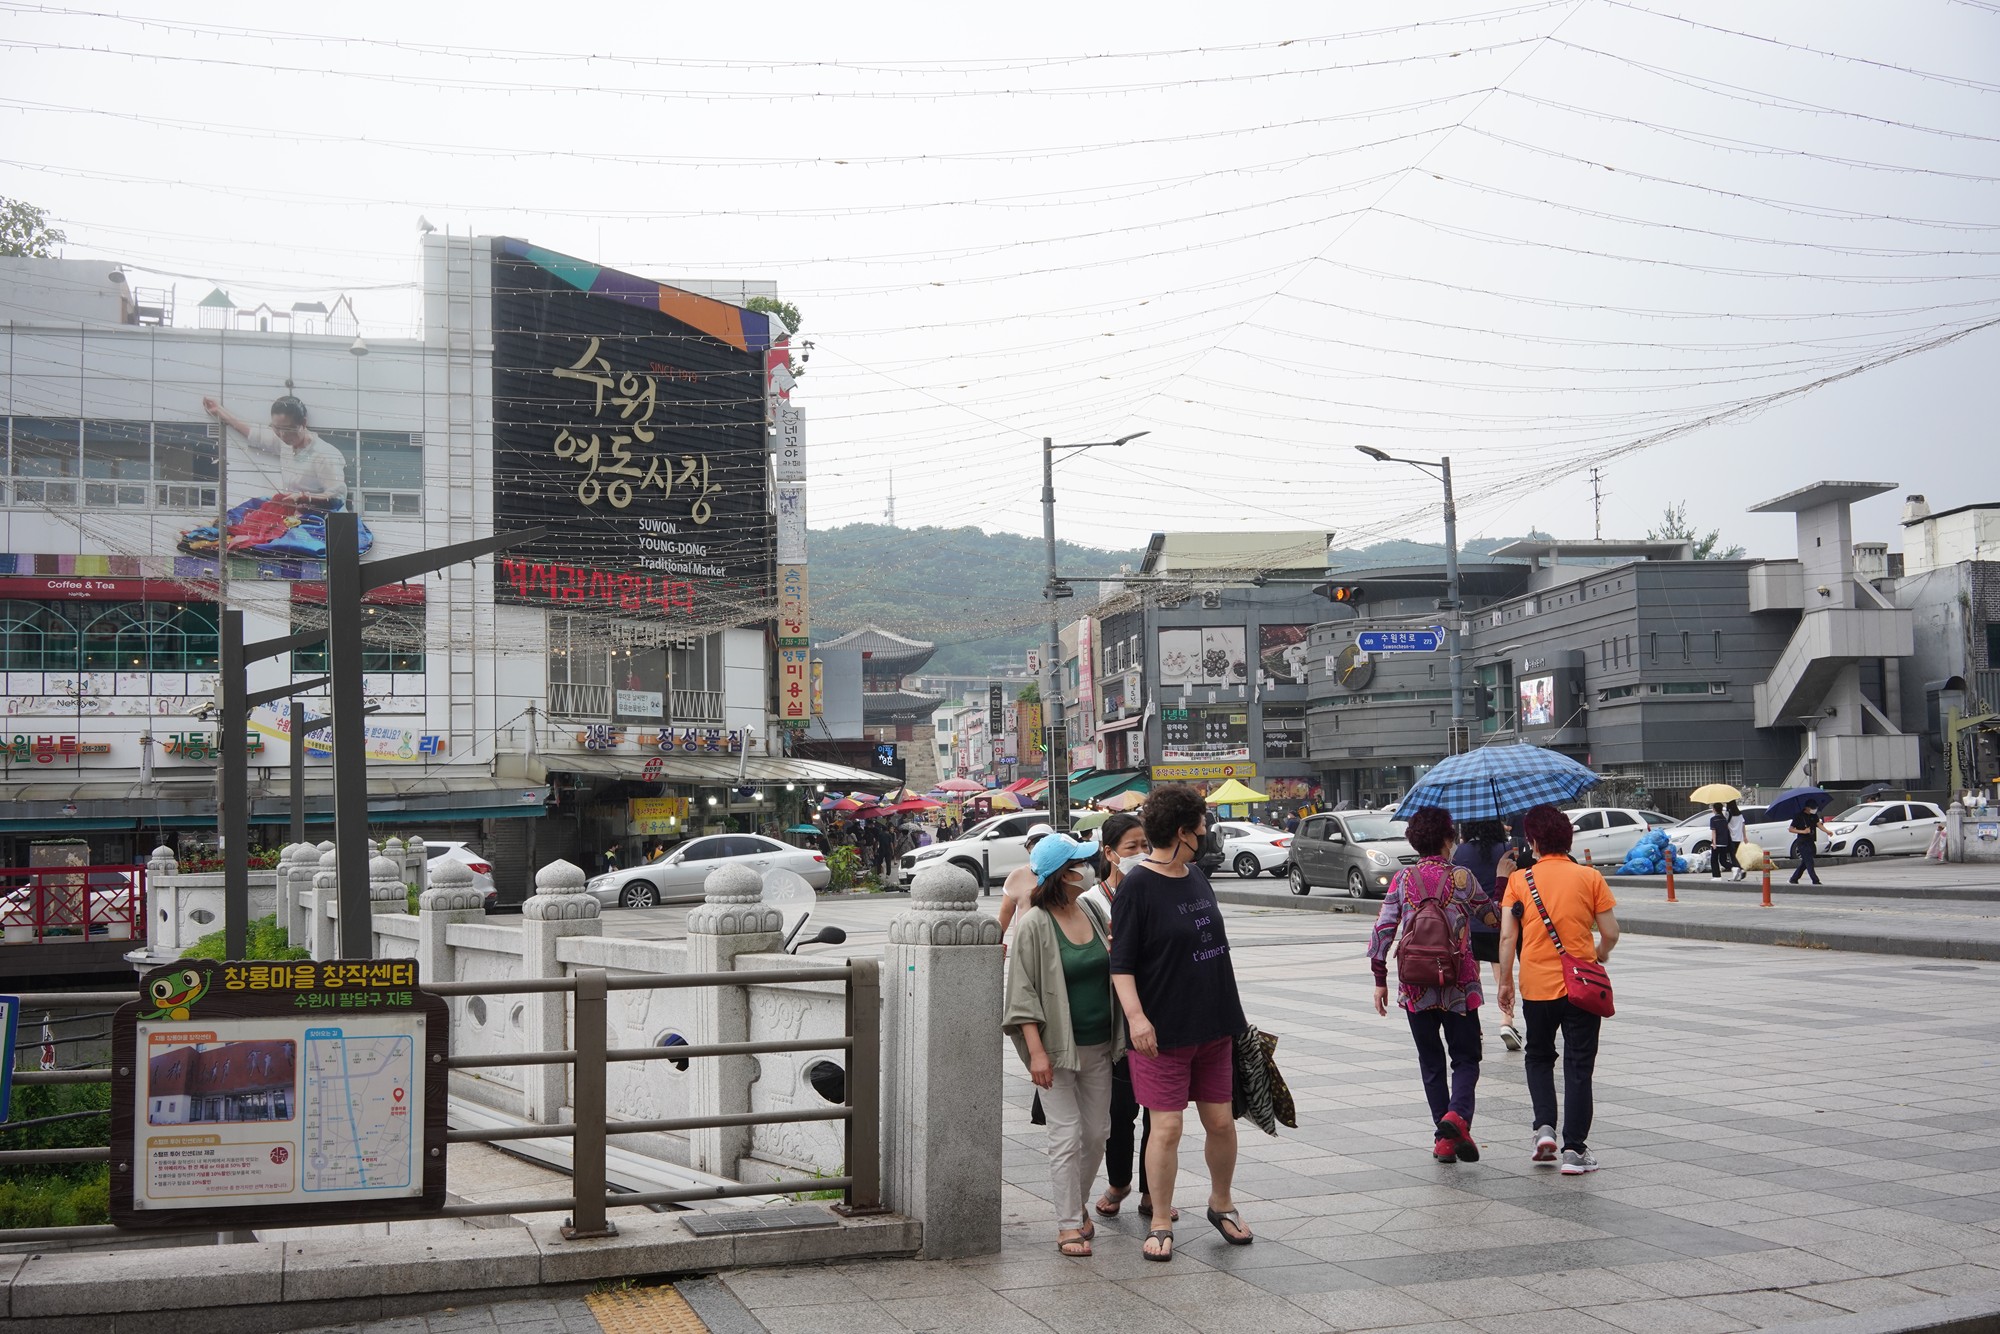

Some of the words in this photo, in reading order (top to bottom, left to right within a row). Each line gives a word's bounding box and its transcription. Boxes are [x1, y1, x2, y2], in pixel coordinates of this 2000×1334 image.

[650, 362, 674, 379] SINCE
[552, 337, 656, 442] 수원
[554, 428, 722, 525] 영동시장
[639, 519, 676, 534] SUWON
[639, 537, 707, 557] YOUNG-DONG
[639, 556, 692, 573] Traditional
[693, 565, 726, 577] Market
[47, 580, 82, 589] Coffee
[85, 581, 92, 589] &
[95, 581, 115, 589] Tea
[1381, 634, 1416, 643] 수원천로
[787, 665, 802, 716] 미용실
[585, 725, 617, 749] 강원도
[657, 727, 743, 752] 정성꽃집
[1195, 915, 1211, 930] pas
[1201, 931, 1212, 943] de
[1192, 945, 1226, 962] t'aimer
[225, 966, 316, 990] 창룡마을
[323, 964, 414, 988] 창작센터
[294, 993, 335, 1008] 수원시
[340, 992, 382, 1007] 팔달구
[386, 991, 413, 1006] 지동
